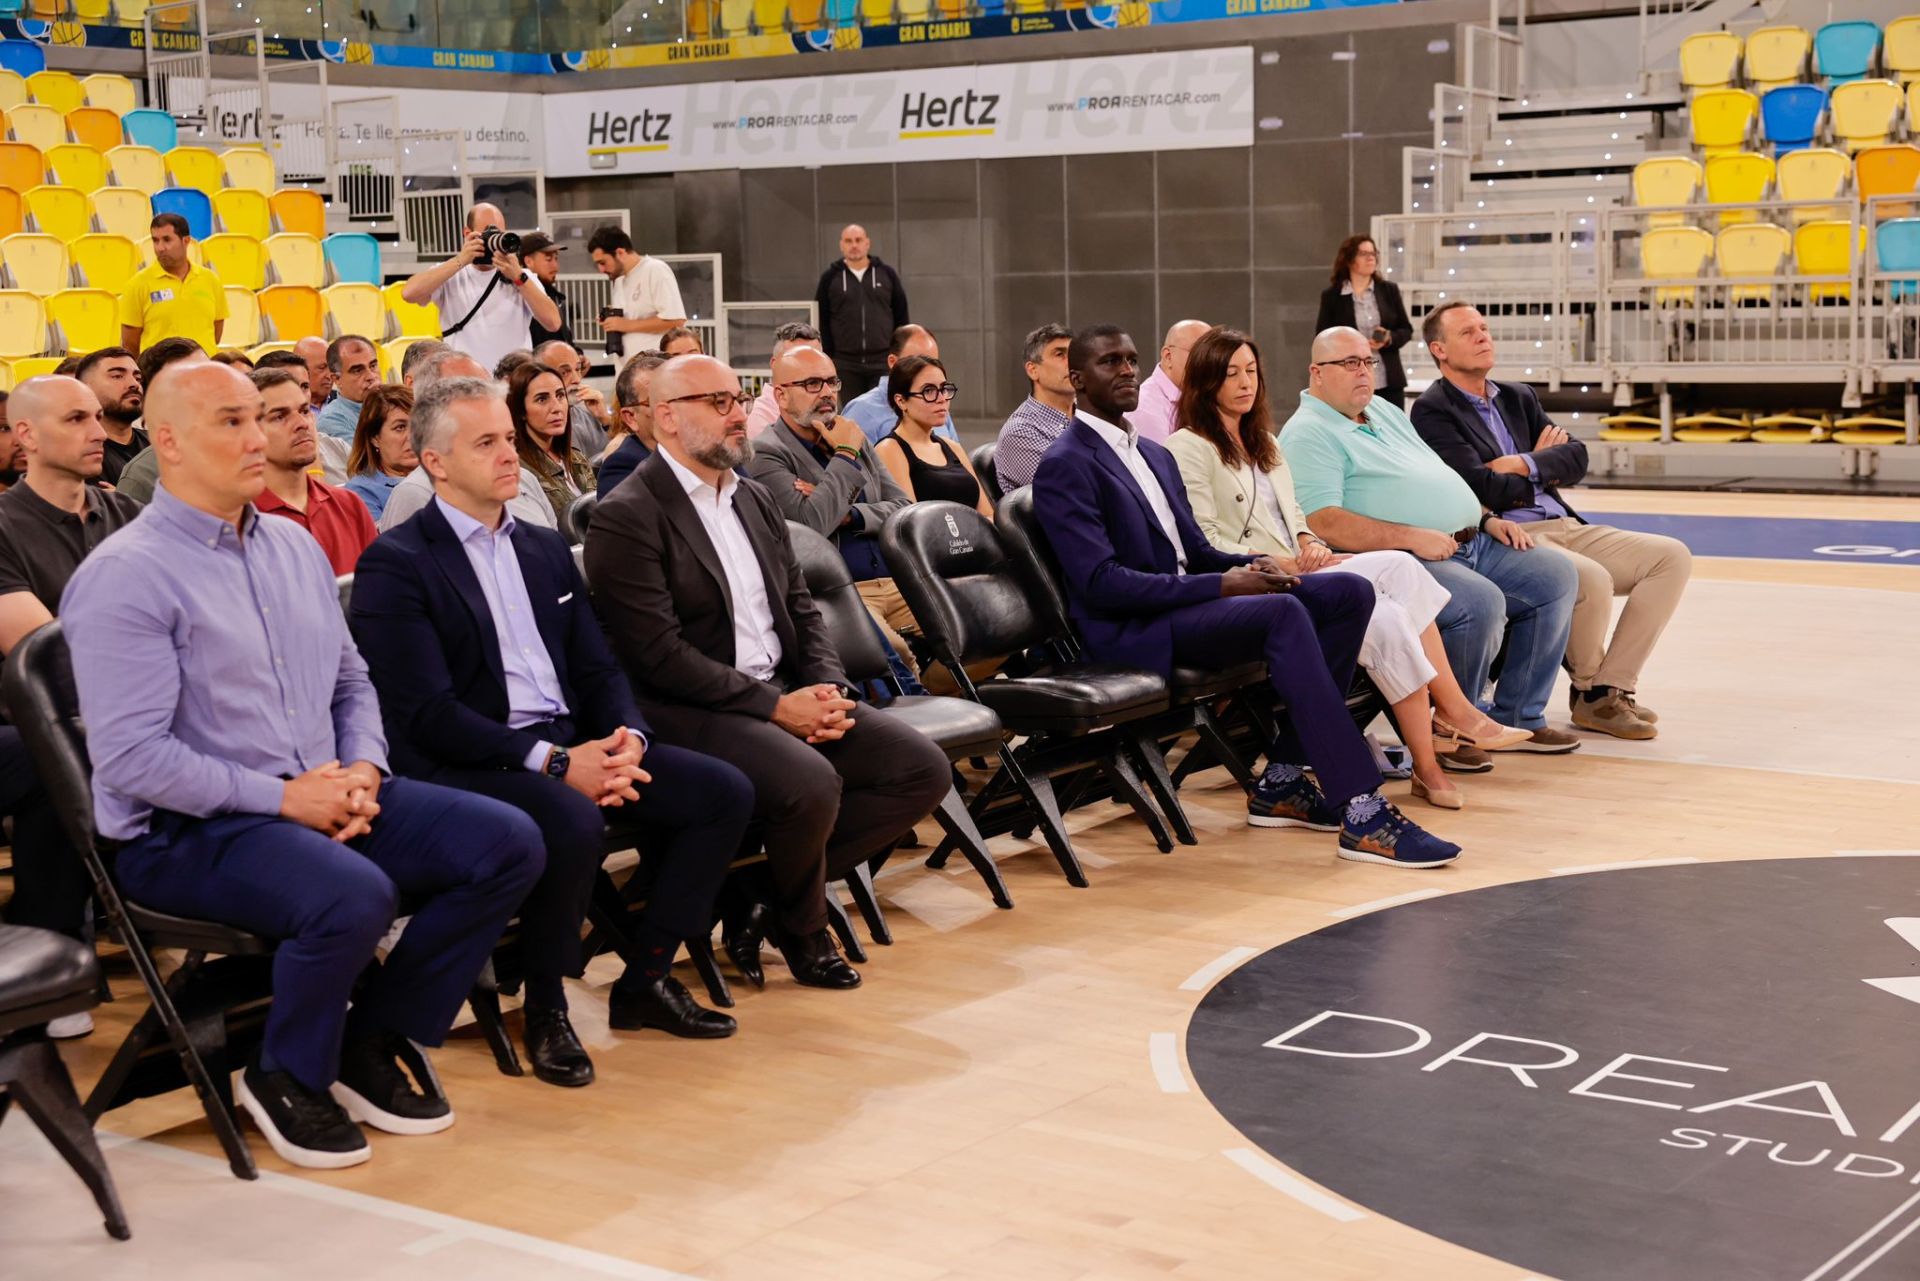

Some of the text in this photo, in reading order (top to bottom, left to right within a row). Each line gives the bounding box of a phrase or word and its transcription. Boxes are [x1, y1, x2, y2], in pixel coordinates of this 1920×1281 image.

[130, 30, 201, 51] GRN CANARI
[899, 21, 972, 42] GRAN CANARIA
[433, 51, 495, 69] GRAN CANARIA
[668, 42, 730, 61] GRAN CANARIA
[900, 88, 1001, 130] Hertz
[1047, 92, 1221, 112] www.PROARENTACAR.com
[587, 108, 673, 145] Hertz
[712, 113, 858, 130] www.PROARENTACAR.com
[354, 123, 371, 139] Te
[476, 128, 530, 143] destino.
[1262, 1010, 1920, 1143] DREA
